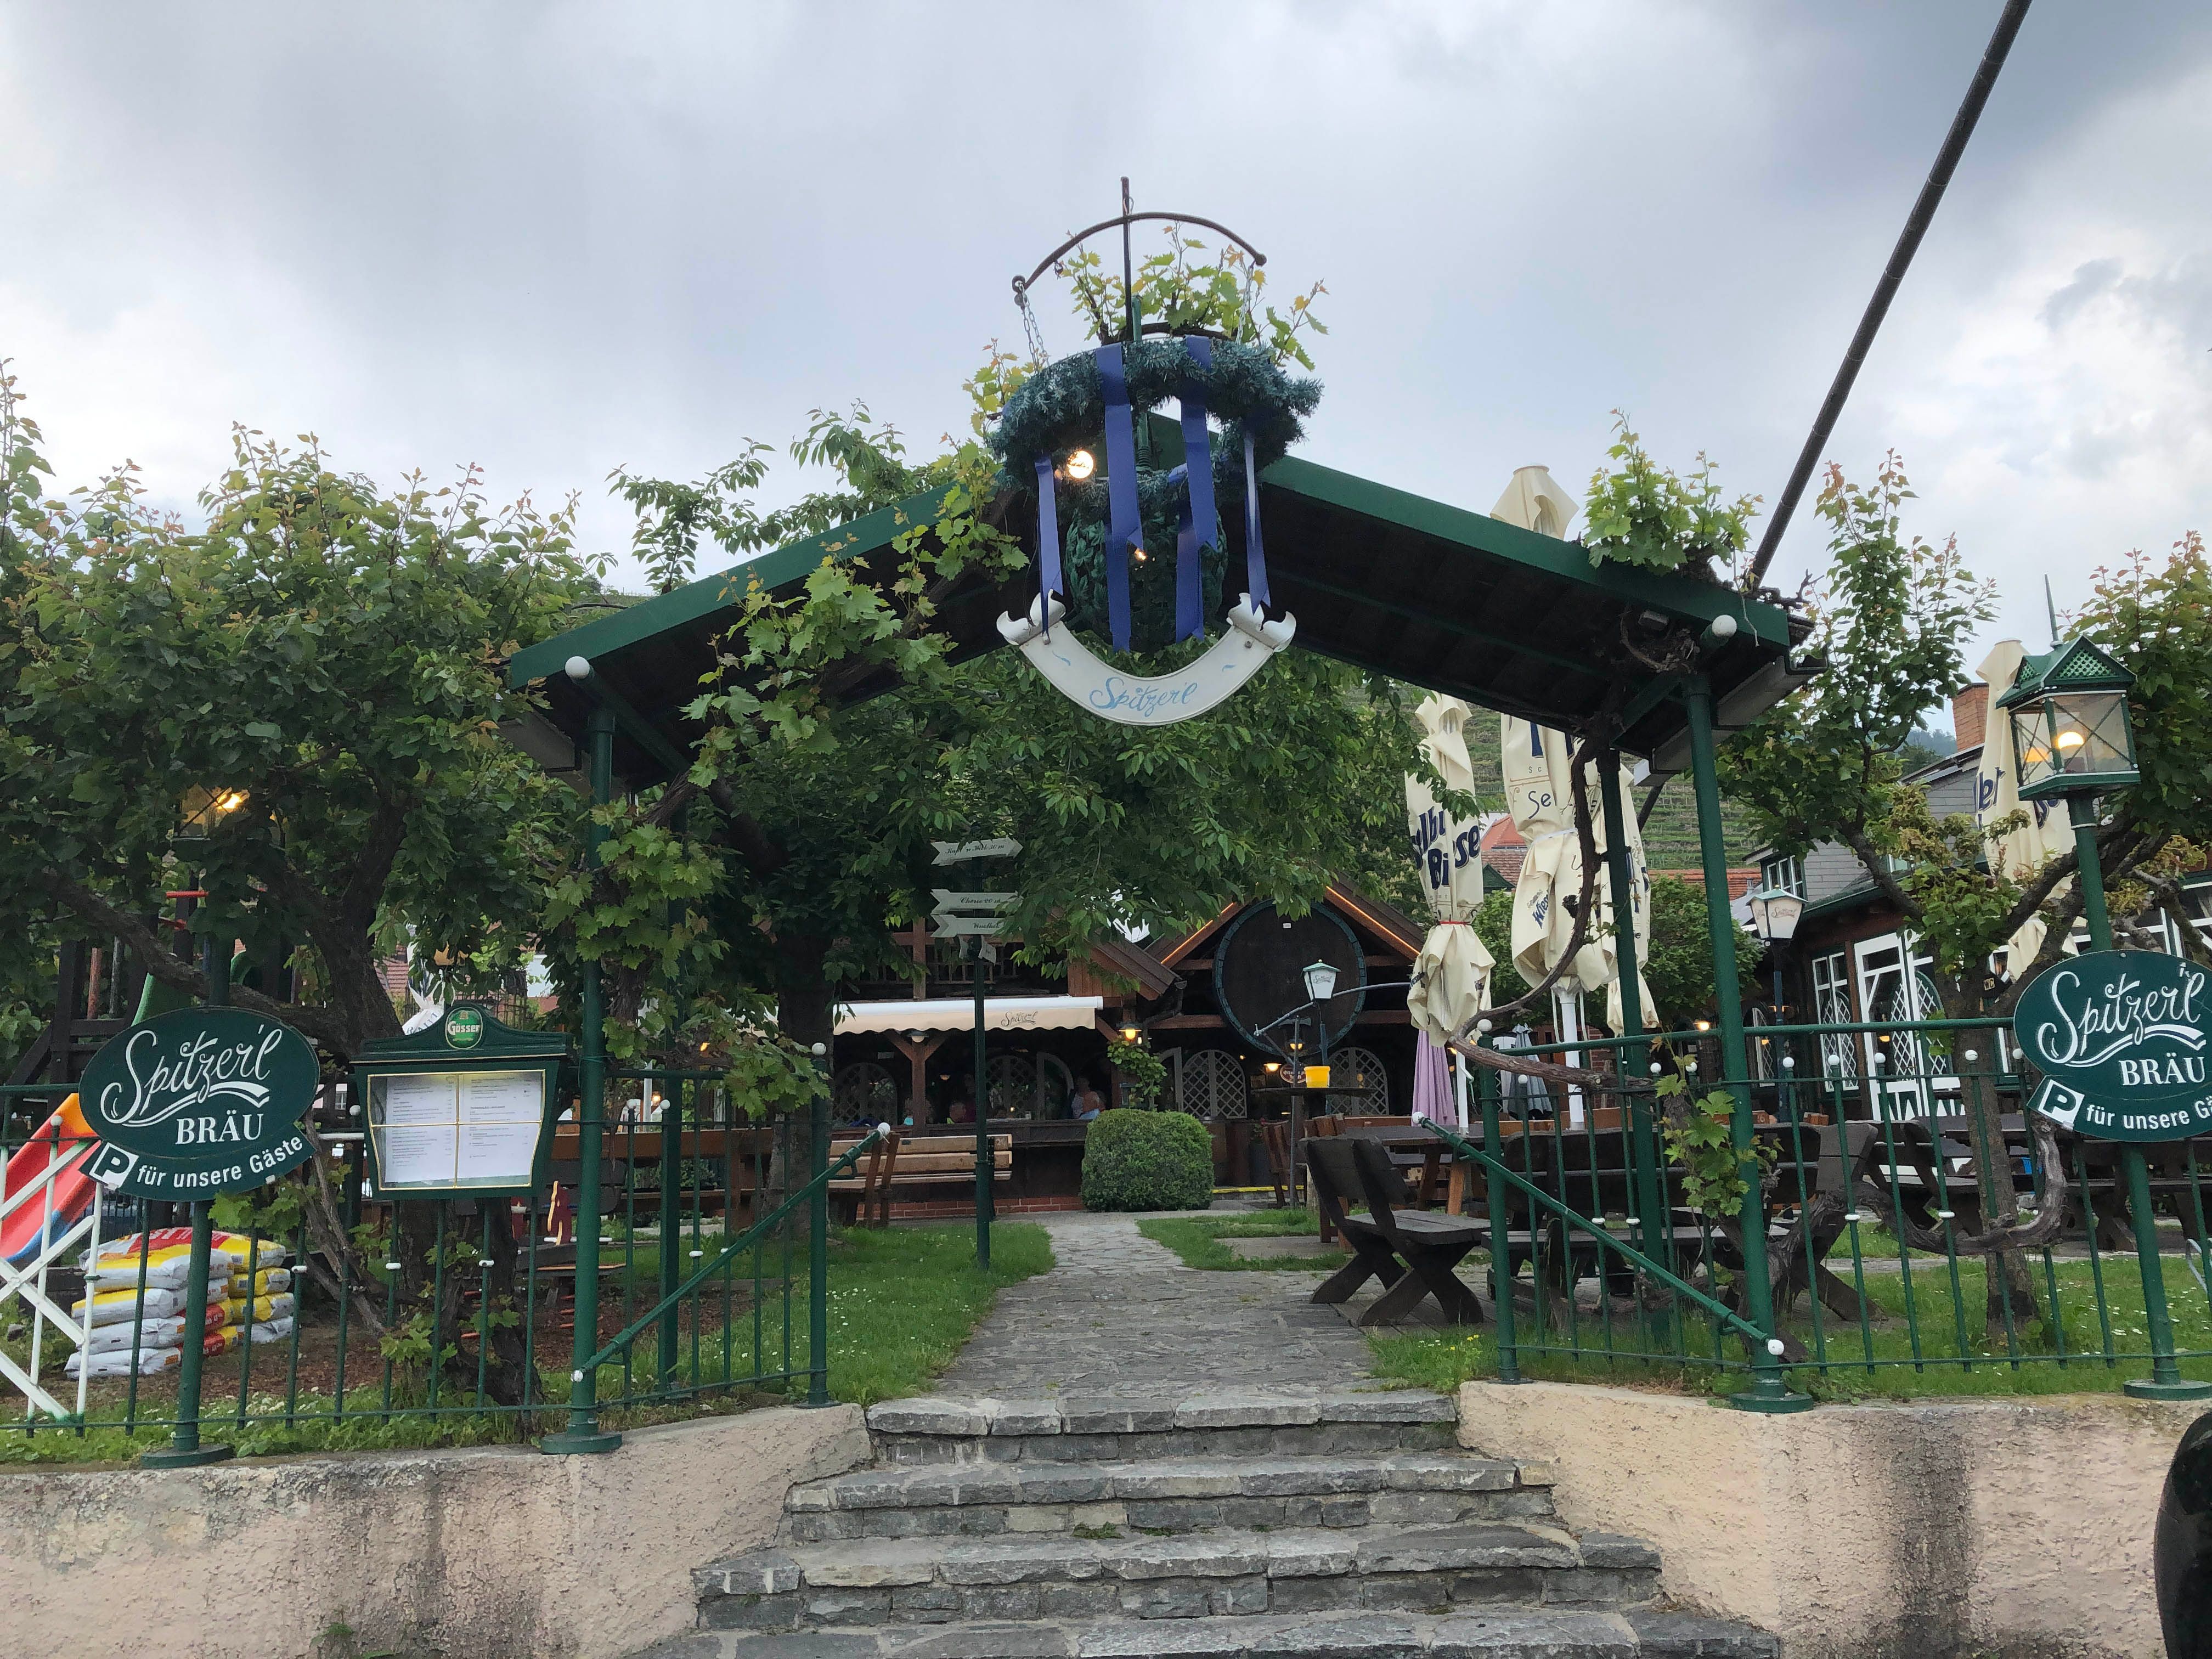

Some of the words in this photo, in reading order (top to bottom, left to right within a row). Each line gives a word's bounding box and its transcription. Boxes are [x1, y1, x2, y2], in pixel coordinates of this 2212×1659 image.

[1984, 979, 1994, 989] WC
[447, 1020, 481, 1036] Gösser
[2118, 1052, 2205, 1086] BRÄU
[2041, 1082, 2079, 1116] P
[2086, 1104, 2115, 1127] für
[2124, 1109, 2191, 1130] unsere
[175, 1109, 264, 1145] BRÄU
[92, 1144, 132, 1180] P
[137, 1164, 166, 1187] für
[173, 1164, 242, 1188] unsere
[249, 1137, 303, 1173] Gäste
